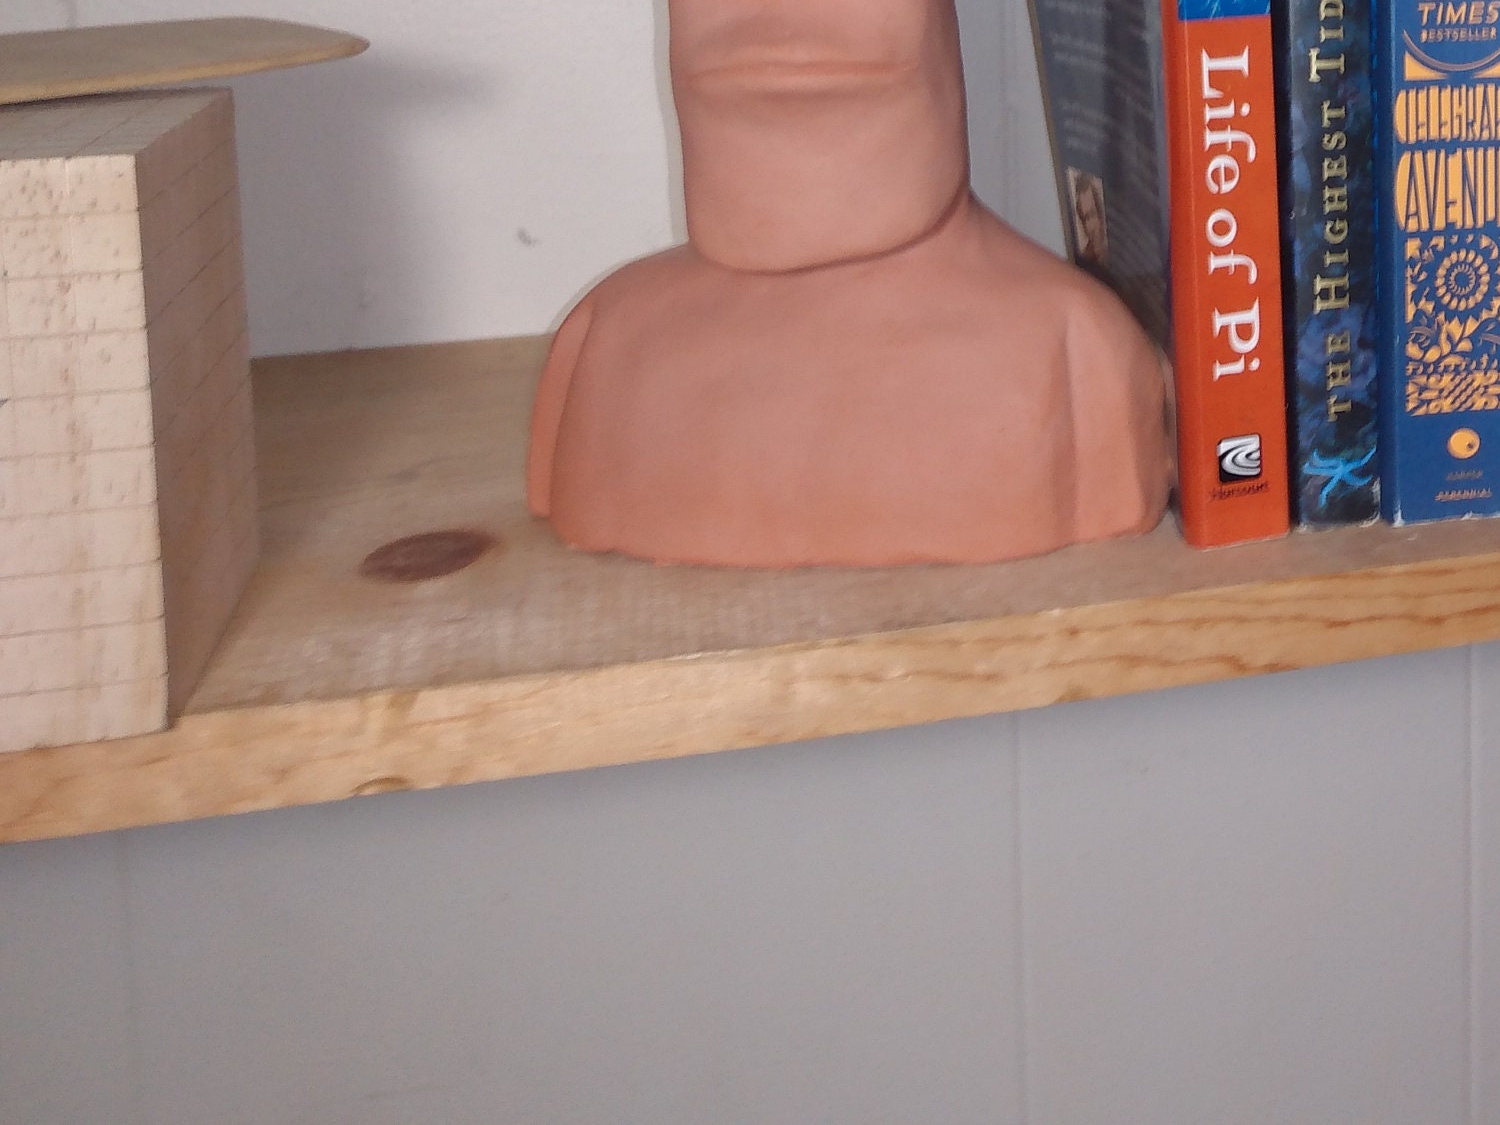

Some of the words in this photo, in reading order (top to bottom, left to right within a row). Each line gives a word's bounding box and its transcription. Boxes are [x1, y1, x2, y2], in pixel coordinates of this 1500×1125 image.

[1421, 27, 1498, 43] BESTSELLER
[1201, 45, 1257, 196] Life
[1204, 210, 1259, 286] of
[1313, 100, 1351, 315] HIGHEST
[1211, 299, 1262, 382] Pi
[1326, 332, 1354, 422] THE
